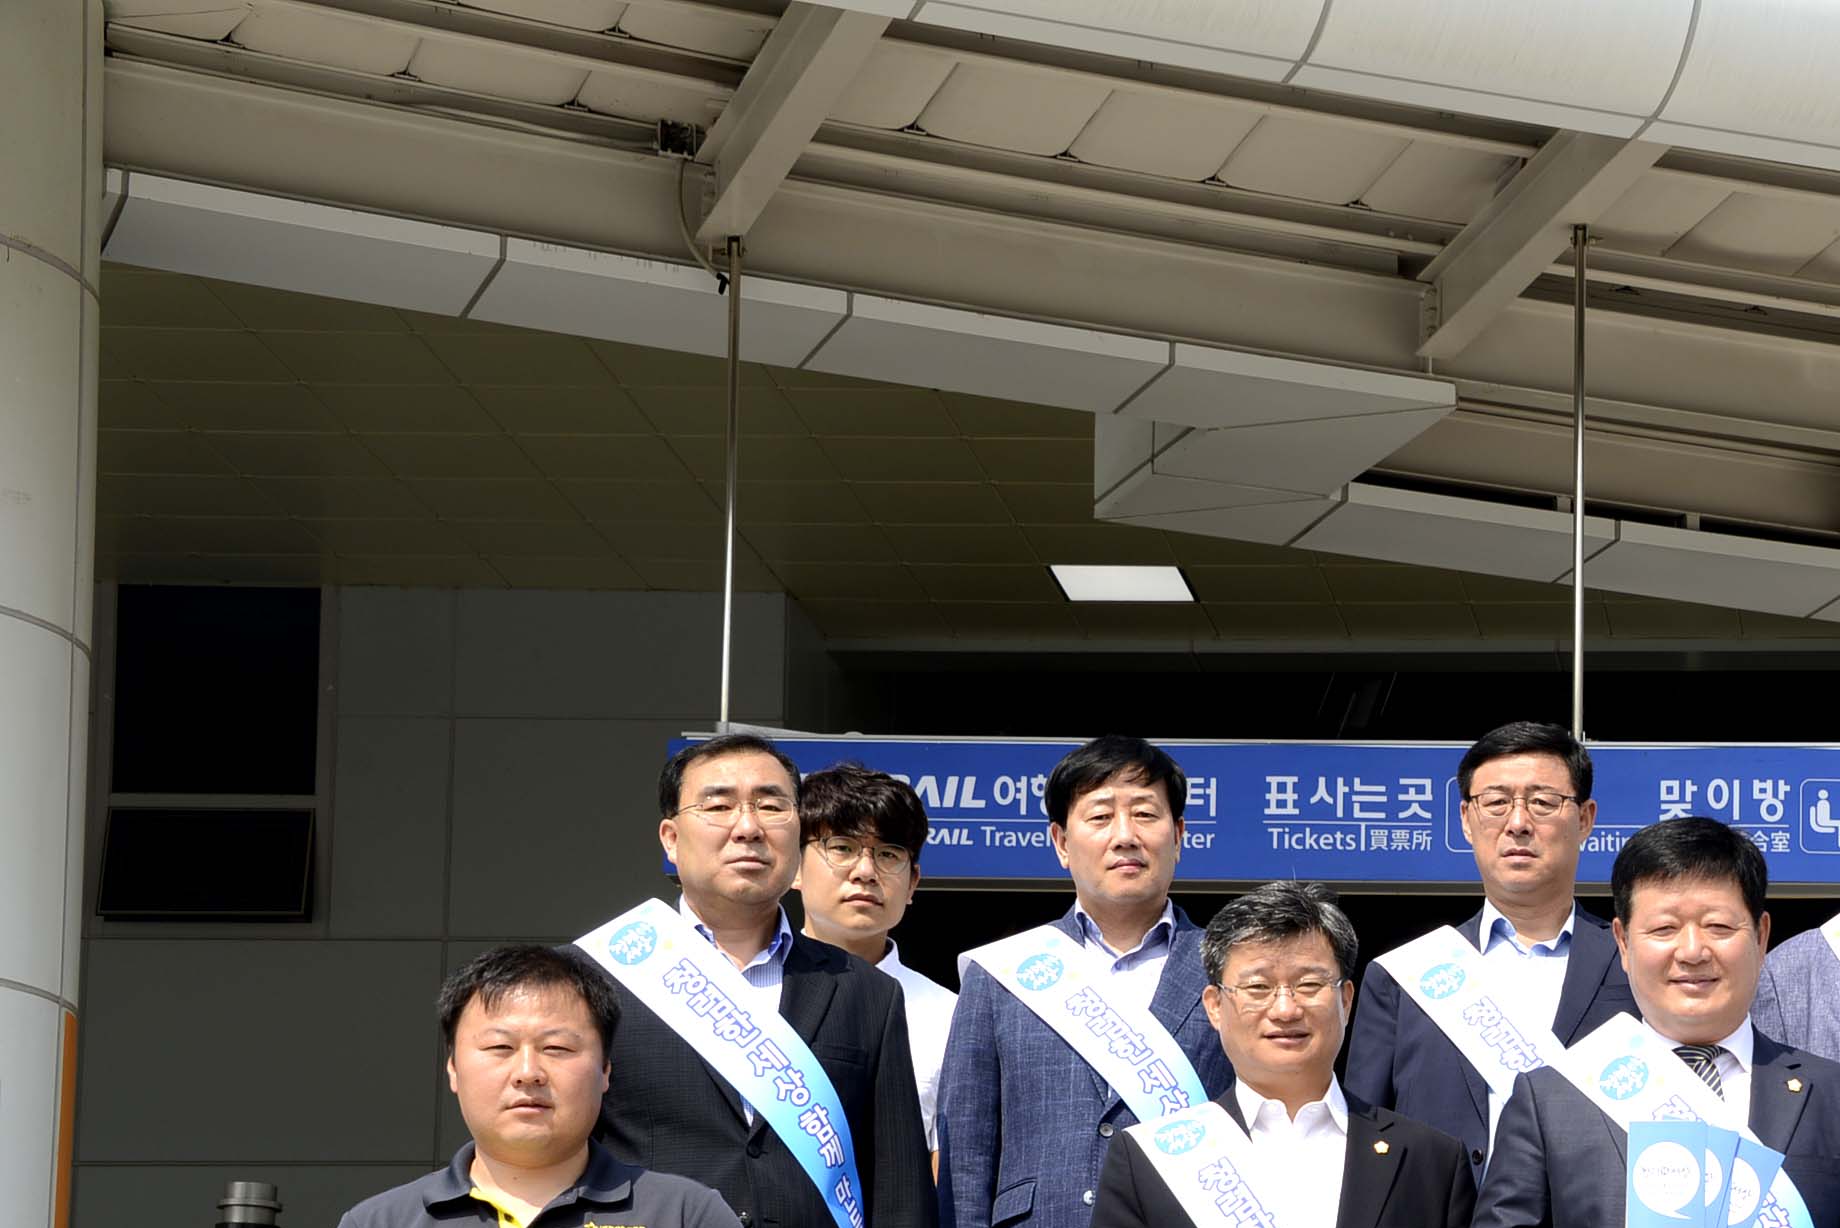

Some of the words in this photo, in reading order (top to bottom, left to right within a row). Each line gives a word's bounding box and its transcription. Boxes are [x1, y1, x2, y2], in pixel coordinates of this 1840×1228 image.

[1658, 778, 1790, 822] 맞이방
[926, 828, 974, 846] RAIL
[1183, 830, 1215, 849] ter
[1267, 828, 1356, 850] Tickets
[1750, 831, 1791, 852] 合室
[798, 1103, 845, 1168] 함께
